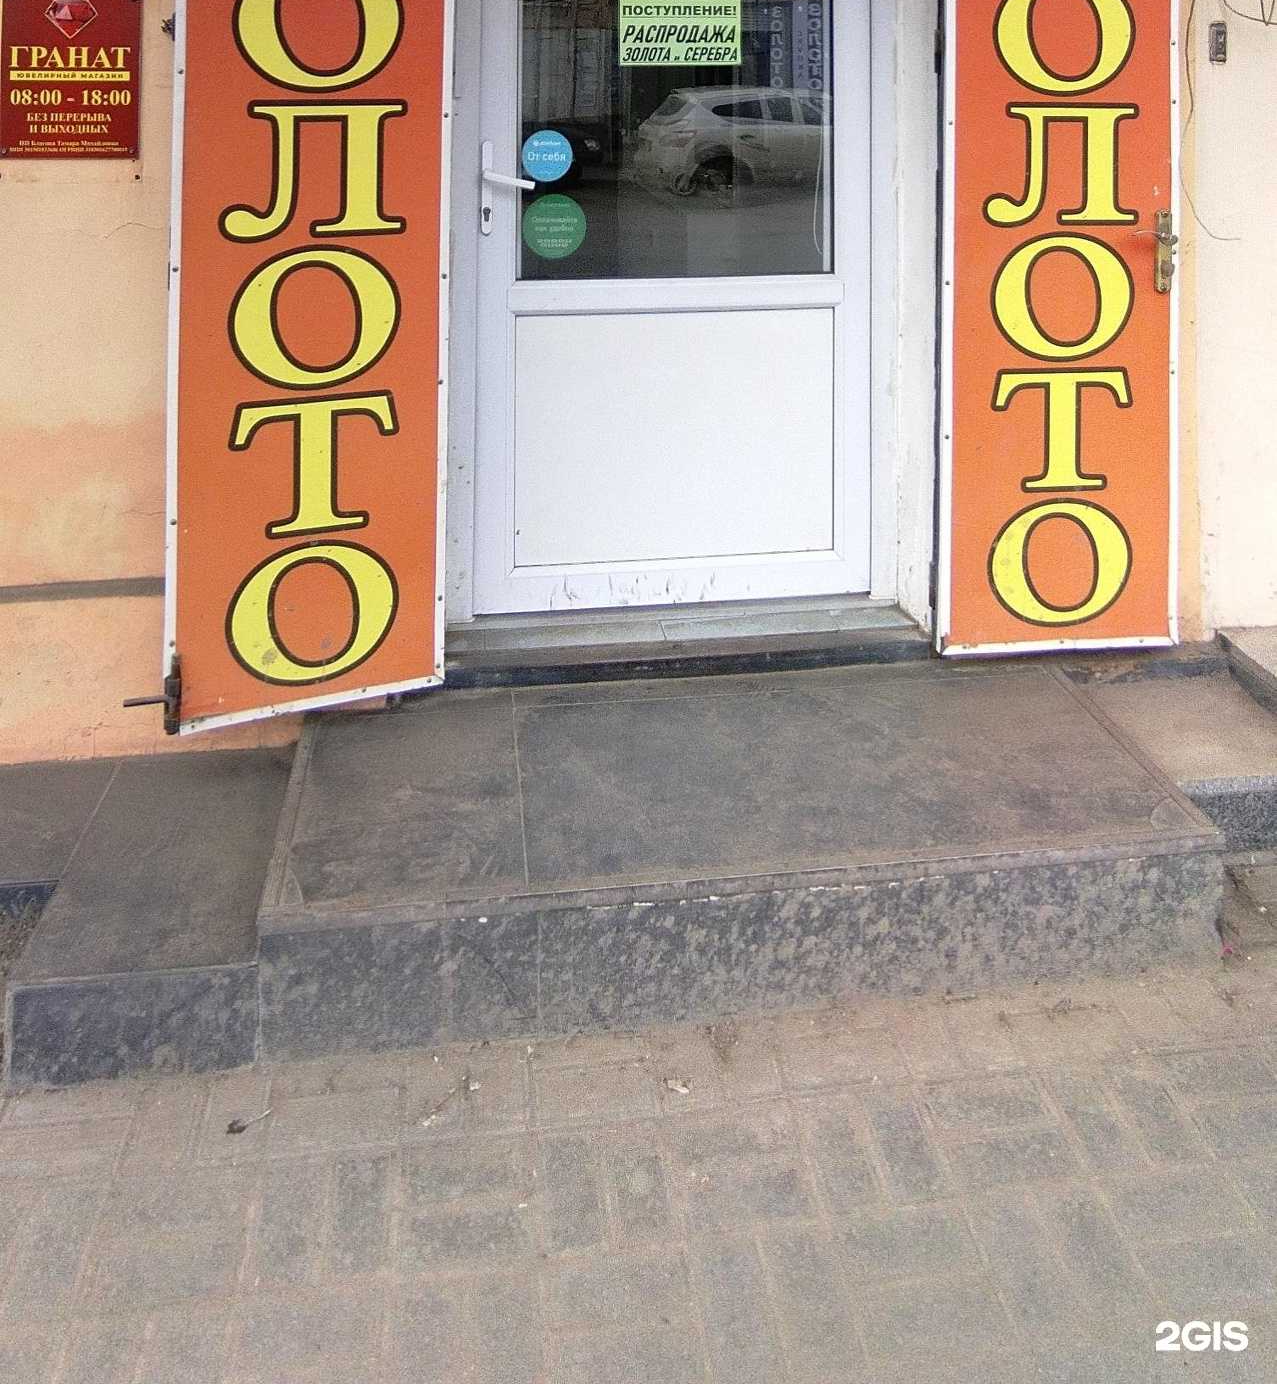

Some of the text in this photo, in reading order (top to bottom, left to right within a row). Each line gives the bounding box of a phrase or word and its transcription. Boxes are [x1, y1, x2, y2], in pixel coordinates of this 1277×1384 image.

[622, 5, 737, 16] ПОСТУПЛЕНИЕ!
[622, 24, 737, 44] РАСПРОДАЖА
[8, 45, 132, 69] ГРАНАТ
[622, 47, 672, 62] ЗОЛОТА
[683, 47, 738, 62] СЕРЕБРА
[10, 89, 62, 106] 08:00
[82, 89, 132, 106] 18:00
[27, 113, 112, 122] БЕЗ ПЕРЕРЫВА
[29, 125, 109, 135] И ВЫХОДНЫХ
[527, 151, 566, 162] От себя
